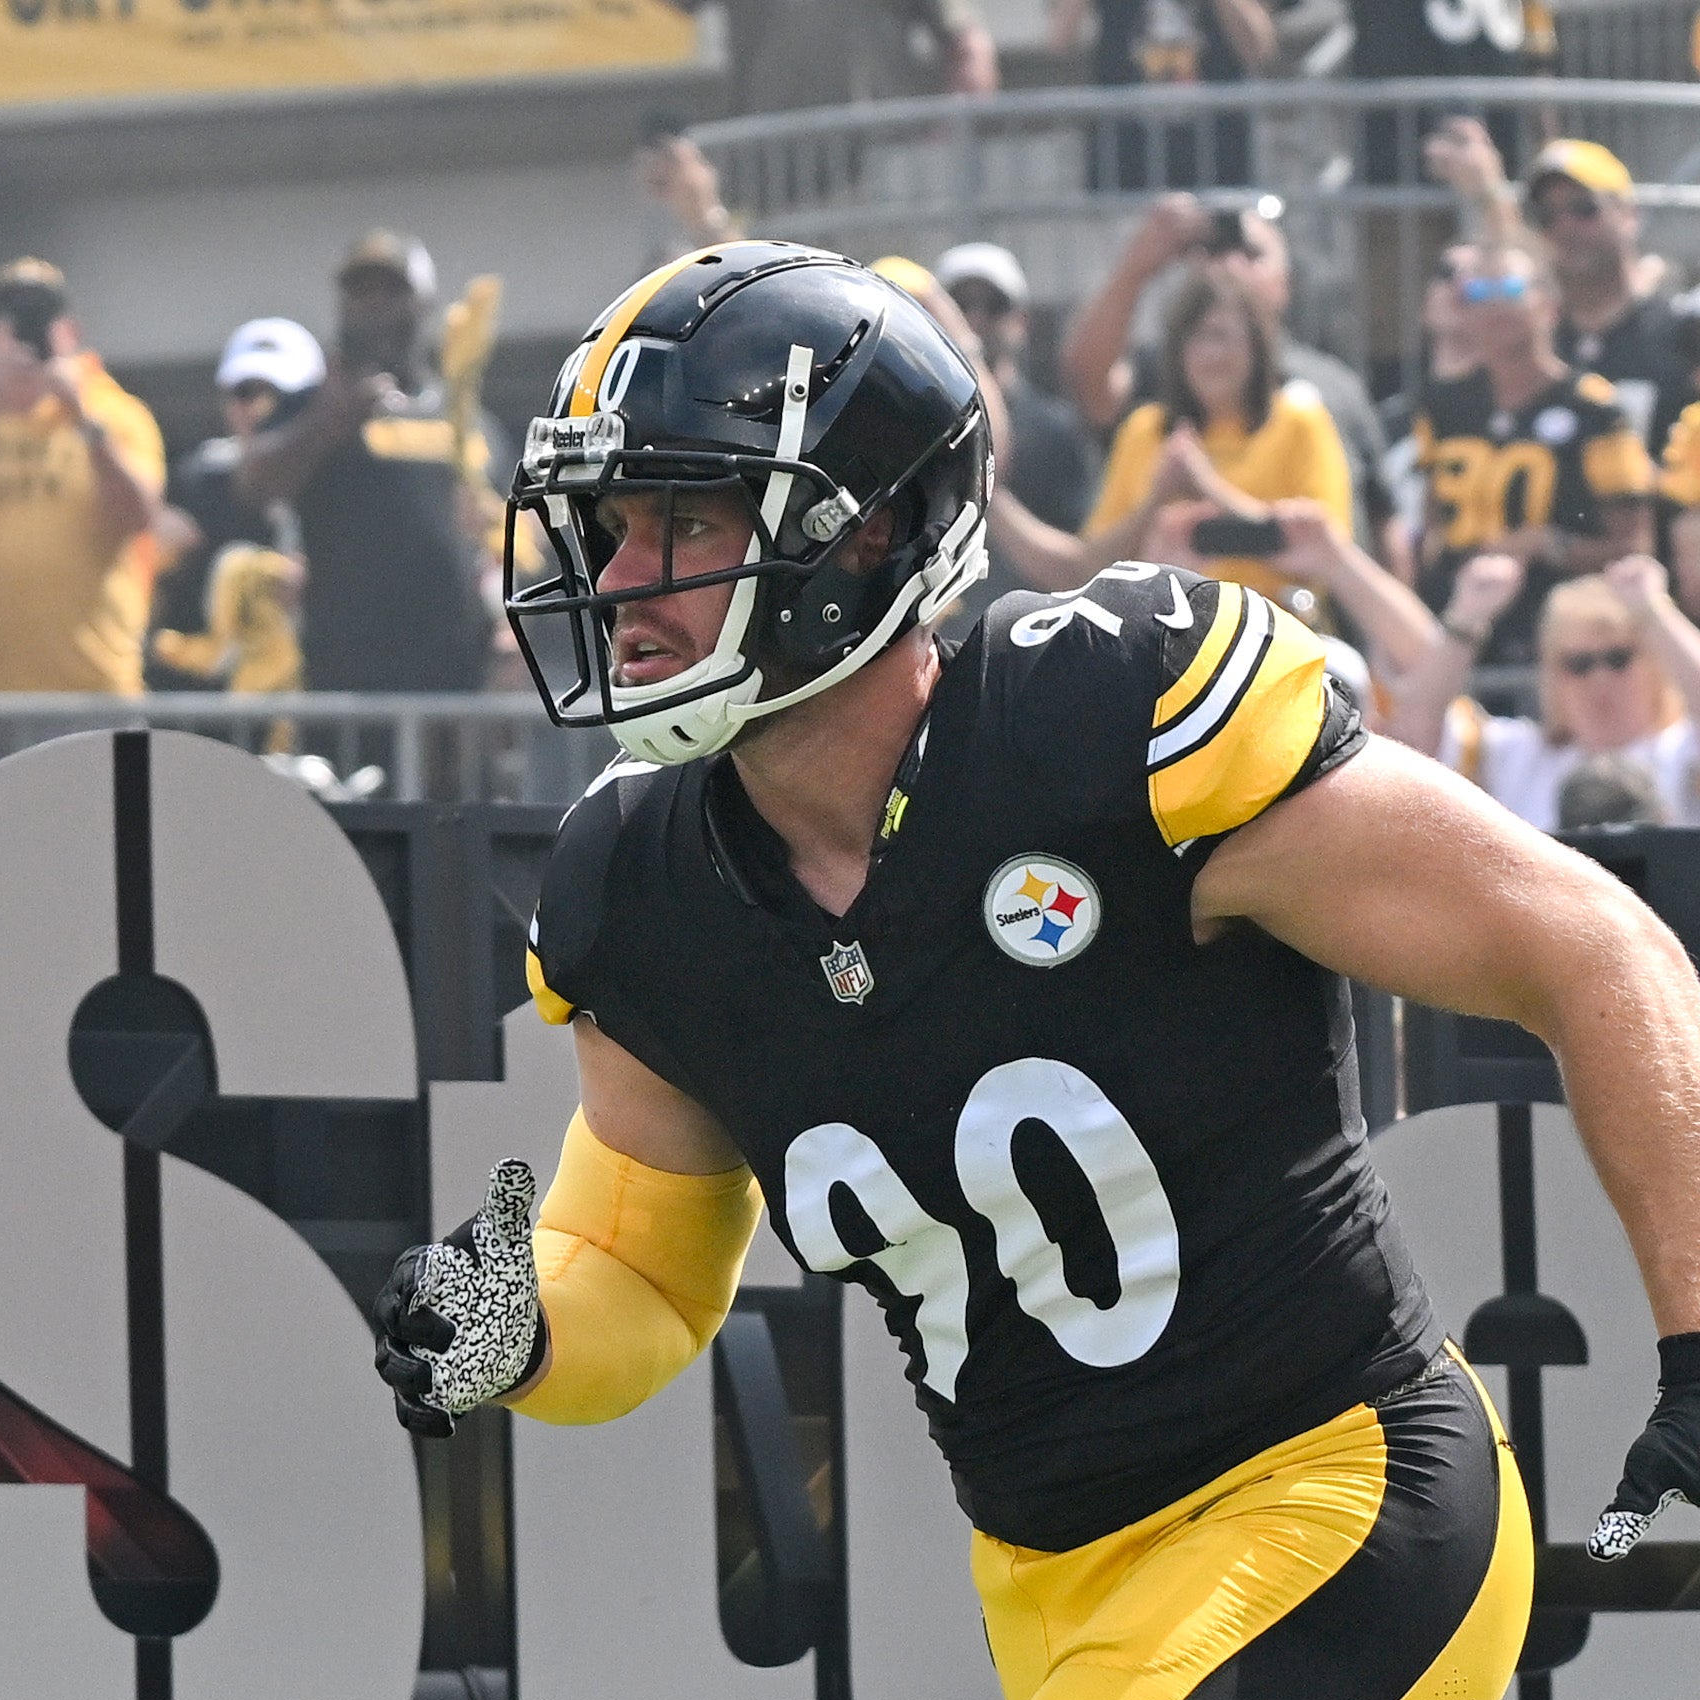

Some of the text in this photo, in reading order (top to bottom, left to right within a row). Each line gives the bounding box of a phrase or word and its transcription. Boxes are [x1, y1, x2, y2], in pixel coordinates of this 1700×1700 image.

[996, 906, 1041, 927] Steelers
[834, 967, 866, 995] NFL
[785, 1057, 1181, 1404] 90
